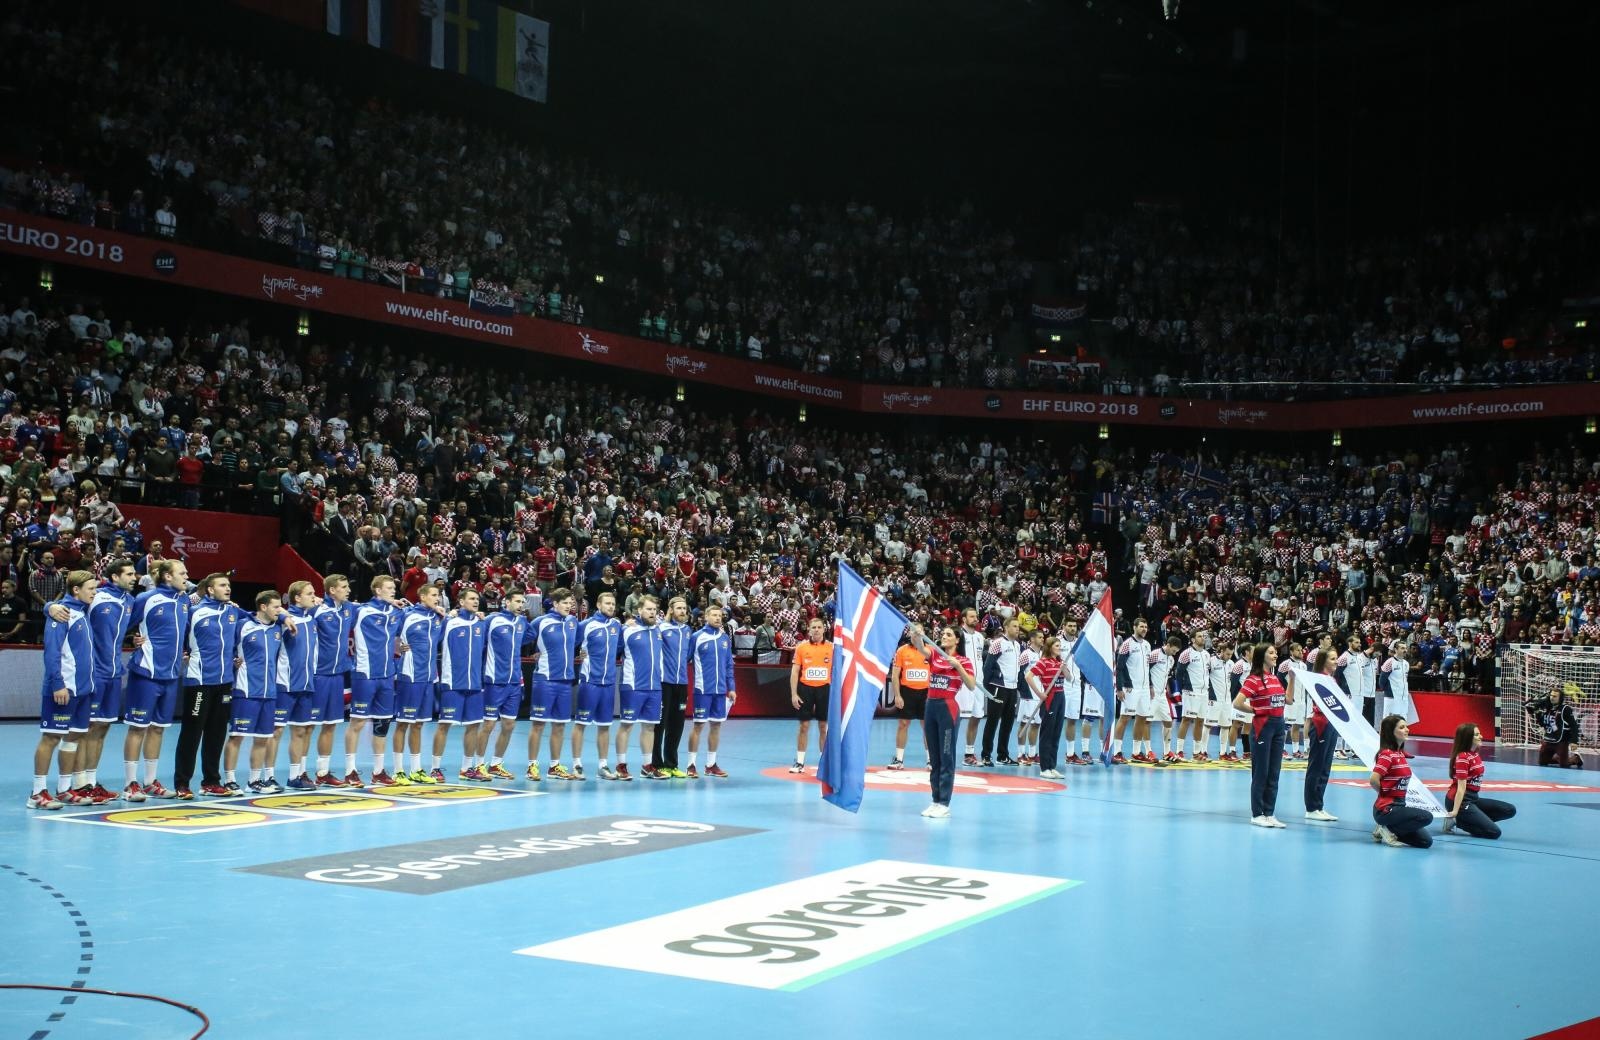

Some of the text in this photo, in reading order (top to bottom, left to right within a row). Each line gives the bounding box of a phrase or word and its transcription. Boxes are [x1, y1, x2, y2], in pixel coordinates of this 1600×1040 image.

[0, 222, 125, 262] EURO 2018
[386, 302, 513, 336] www.ehf-euro.com
[754, 374, 843, 399] www.ehf-euro.com
[1023, 399, 1139, 416] EHF EURO 2018
[1412, 401, 1544, 418] www.ehf-euro.com
[191, 691, 203, 716] Kempa
[305, 829, 649, 883] Gjensidige
[664, 875, 989, 964] gorenje
